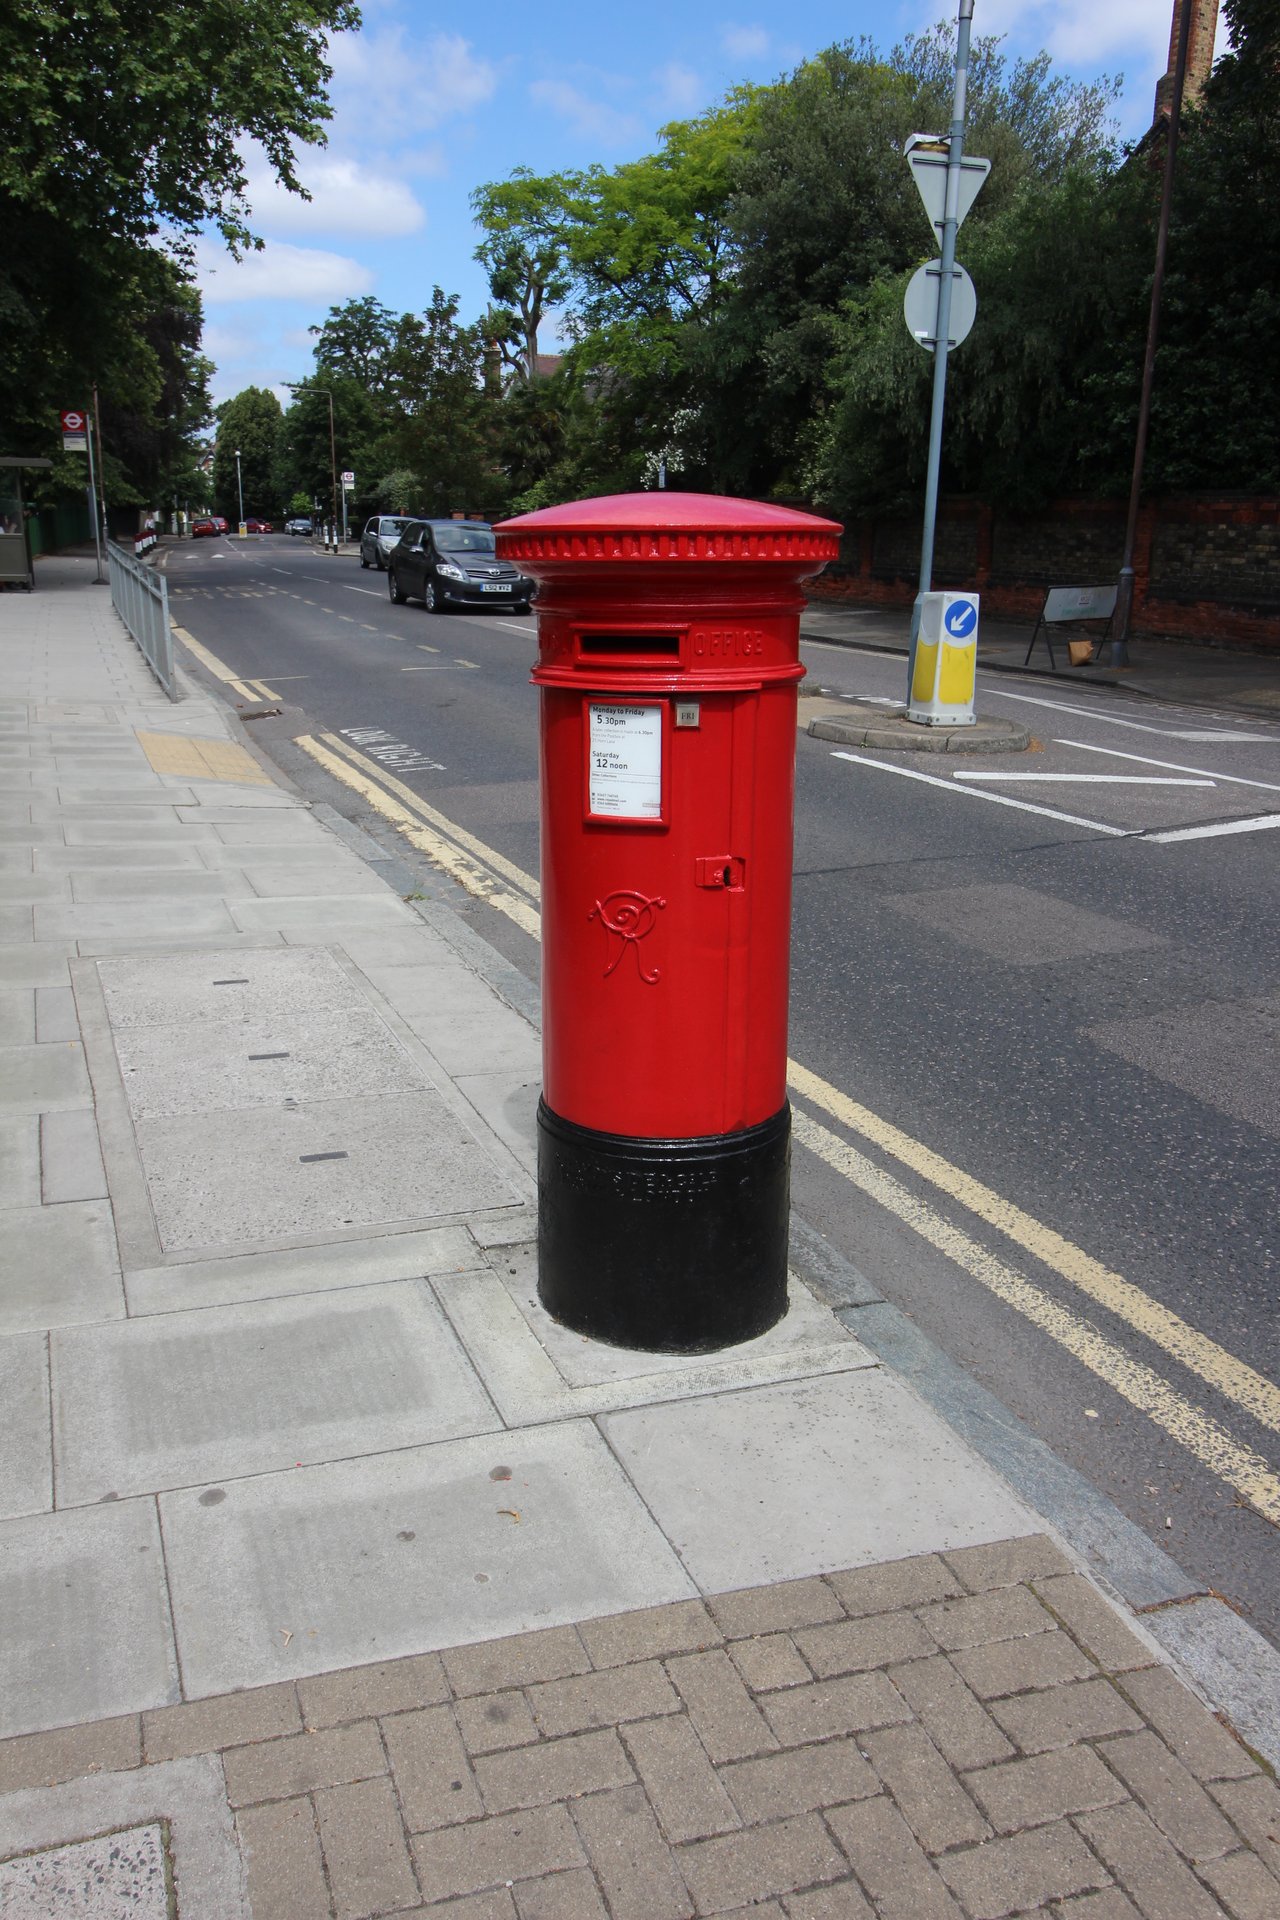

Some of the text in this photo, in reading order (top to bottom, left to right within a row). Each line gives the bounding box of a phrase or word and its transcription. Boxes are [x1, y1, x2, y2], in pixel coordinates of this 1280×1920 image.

[693, 630, 763, 657] OFFICE
[593, 706, 617, 716] Monday
[625, 708, 645, 717] Friday
[681, 712, 695, 720] FRI
[597, 714, 626, 726] 5.30pm
[339, 726, 447, 772] LOOK RIGHT
[592, 750, 619, 759] Saturday
[596, 758, 608, 768] 12
